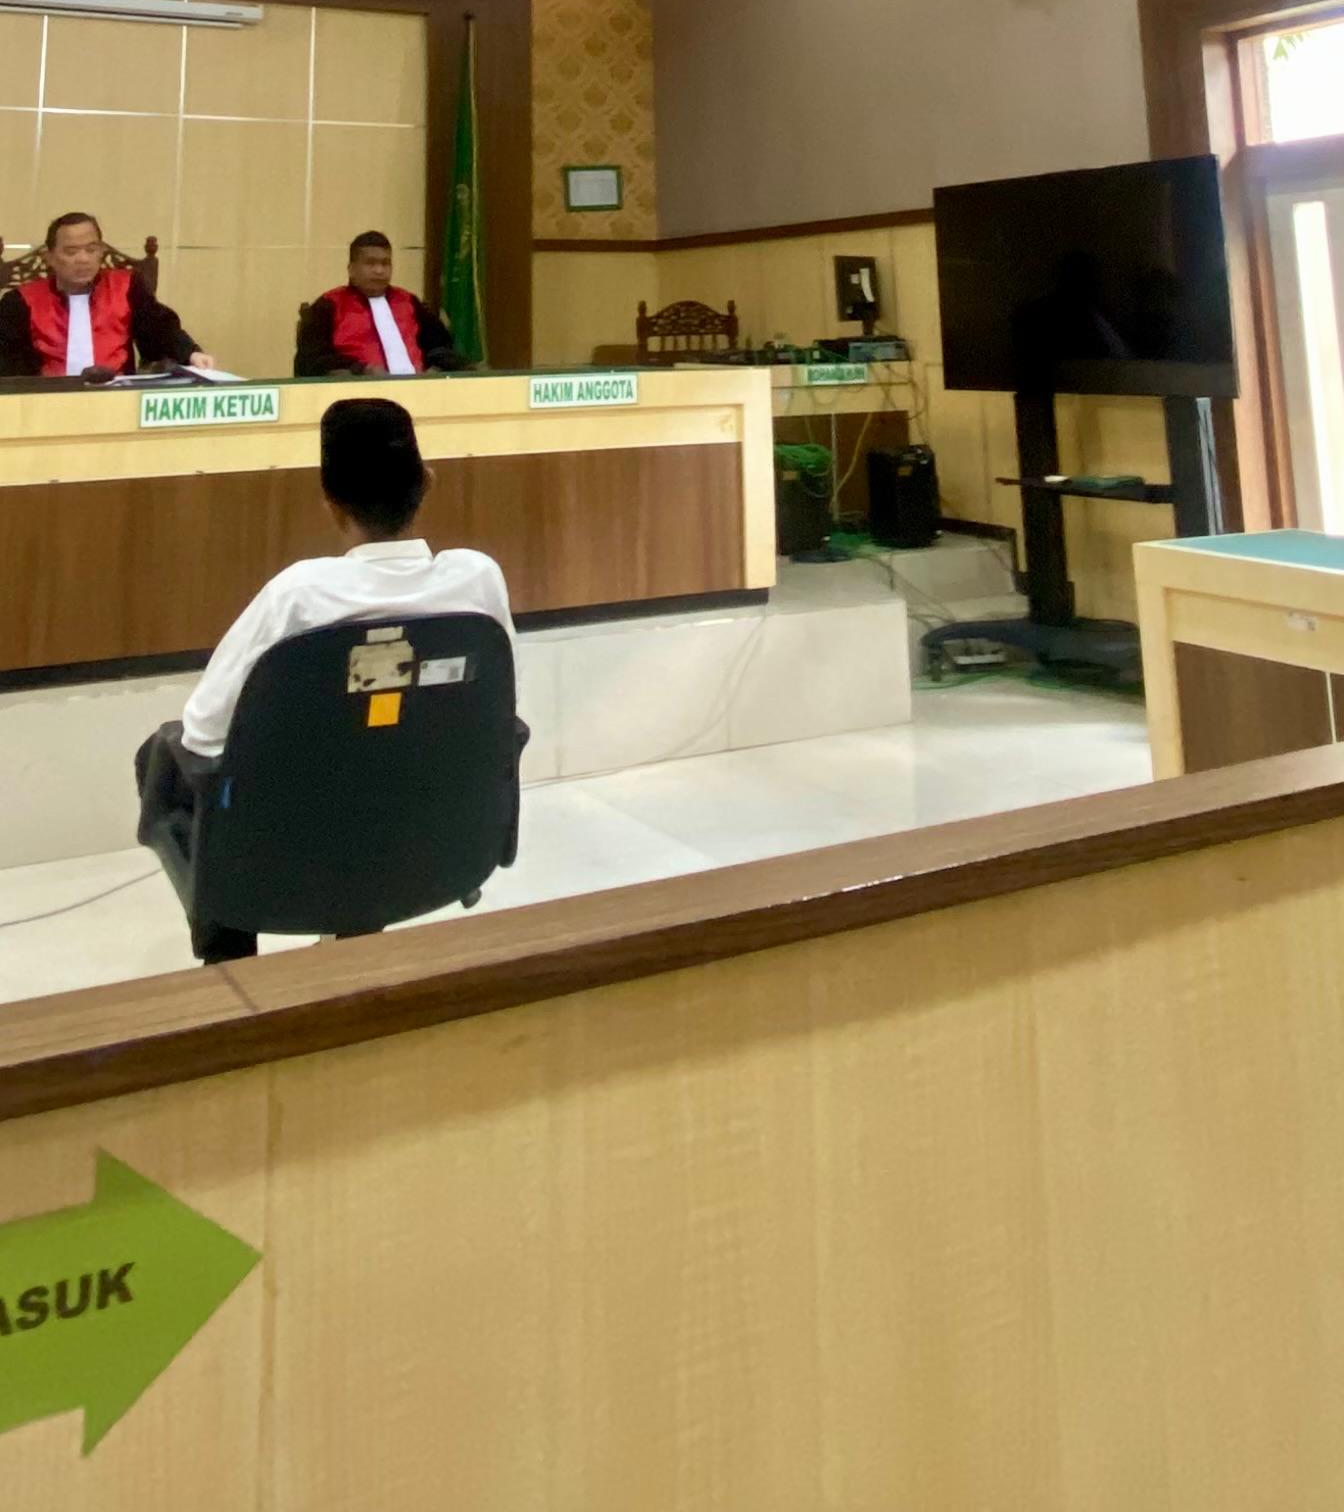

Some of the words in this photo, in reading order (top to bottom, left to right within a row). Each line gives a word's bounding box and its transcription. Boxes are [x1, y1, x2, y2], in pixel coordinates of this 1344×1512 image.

[533, 382, 573, 403] HAKIM
[577, 380, 634, 400] ANGGOTA
[145, 397, 207, 421] HAKIM
[213, 393, 274, 418] KETUA
